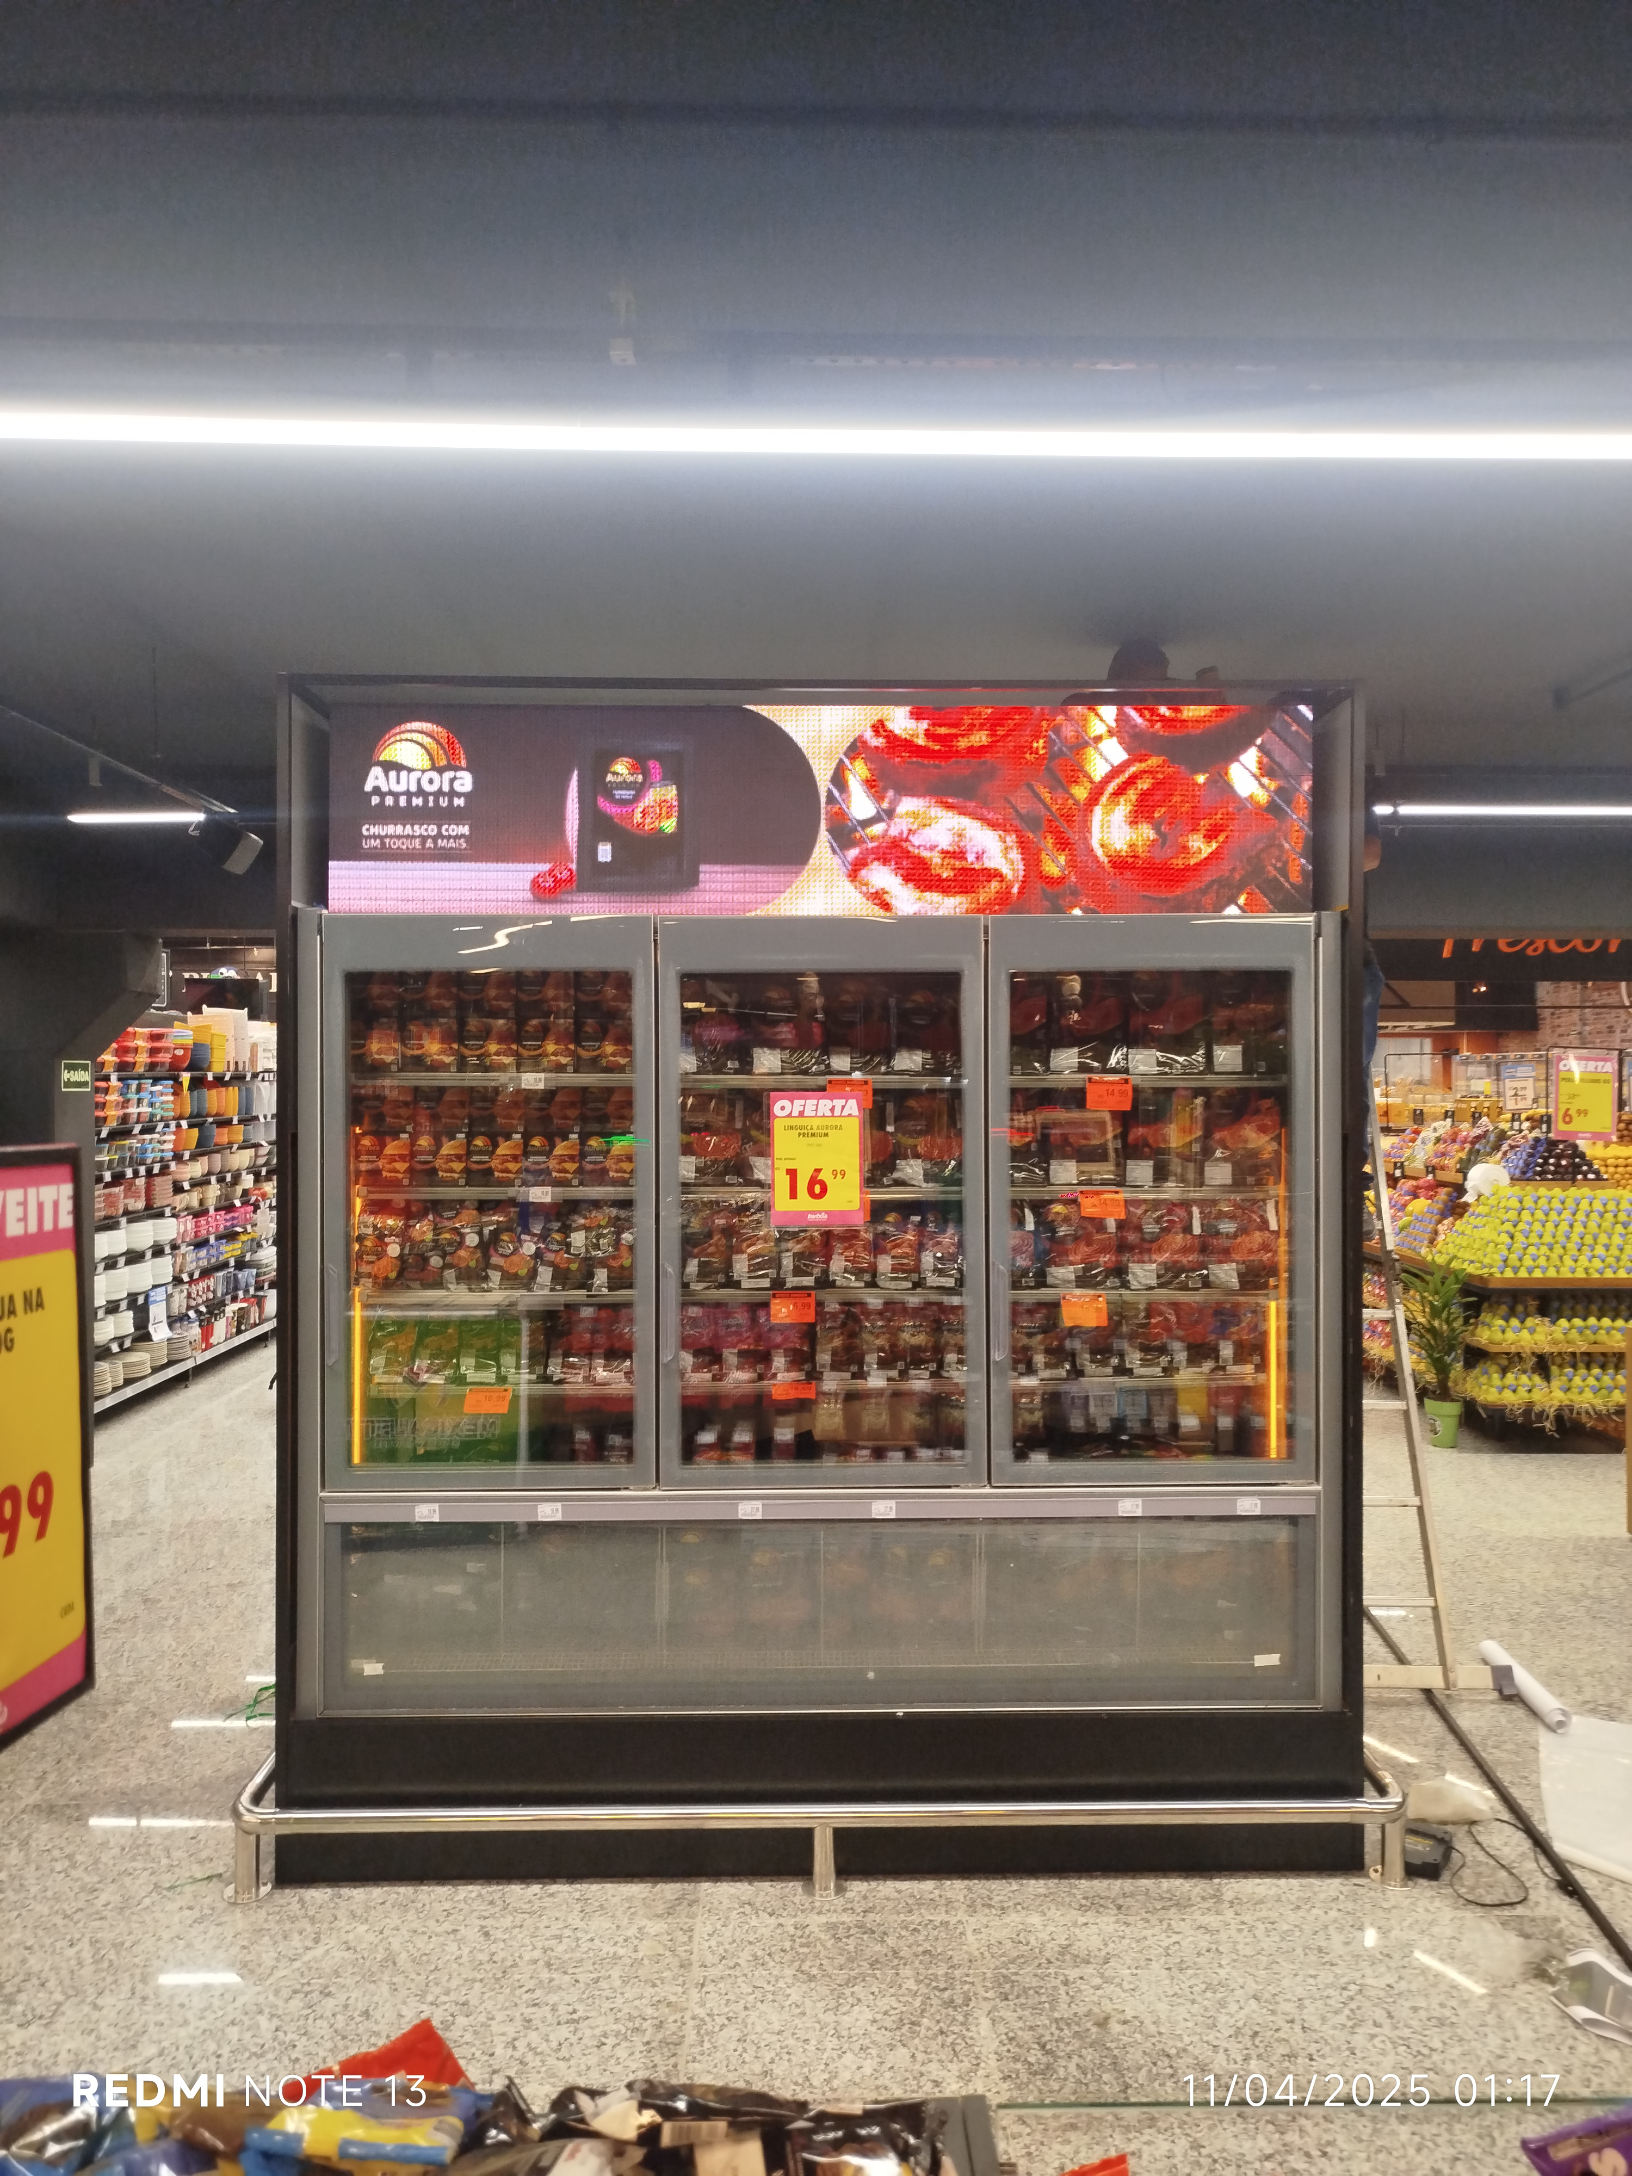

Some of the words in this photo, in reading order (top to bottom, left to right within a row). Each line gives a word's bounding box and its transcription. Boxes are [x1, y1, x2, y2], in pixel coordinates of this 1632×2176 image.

[364, 766, 473, 792] Aurora
[371, 795, 465, 807] PREMIUM
[362, 824, 438, 836] CHURRASCO
[441, 824, 470, 836] COM
[362, 838, 381, 849] UM
[384, 838, 422, 850] TOQUE
[425, 838, 434, 849] A
[70, 1069, 89, 1082] SAÍDA
[773, 1099, 860, 1117] OFERTA
[786, 1168, 828, 1200] 16
[831, 1169, 847, 1180] 99
[0, 1183, 74, 1238] EITE
[23, 1287, 45, 1315] NA
[0, 1326, 15, 1354] G
[0, 1471, 54, 1559] 99
